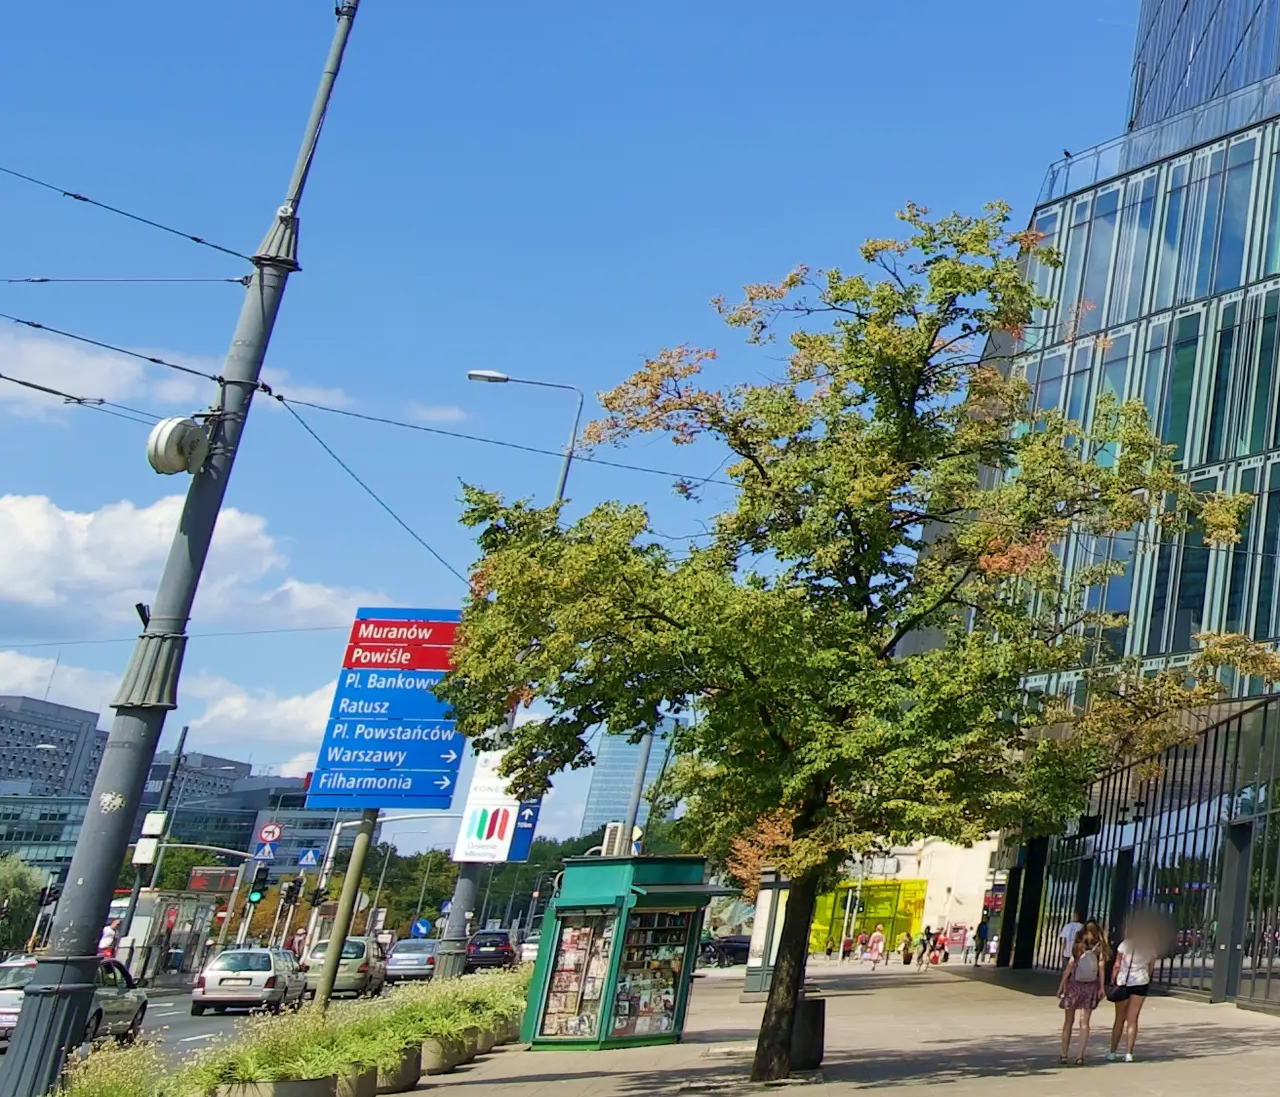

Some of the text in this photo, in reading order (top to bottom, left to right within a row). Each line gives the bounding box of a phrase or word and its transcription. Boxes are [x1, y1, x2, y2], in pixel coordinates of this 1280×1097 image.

[358, 623, 433, 640] Muranów
[351, 648, 412, 664] Powiśle
[344, 673, 362, 689] Pl.
[338, 698, 390, 714] Ratusz
[332, 721, 456, 741] Pl. Powstańców
[327, 746, 408, 766] Warszawy
[319, 773, 412, 790] Filharmonia
